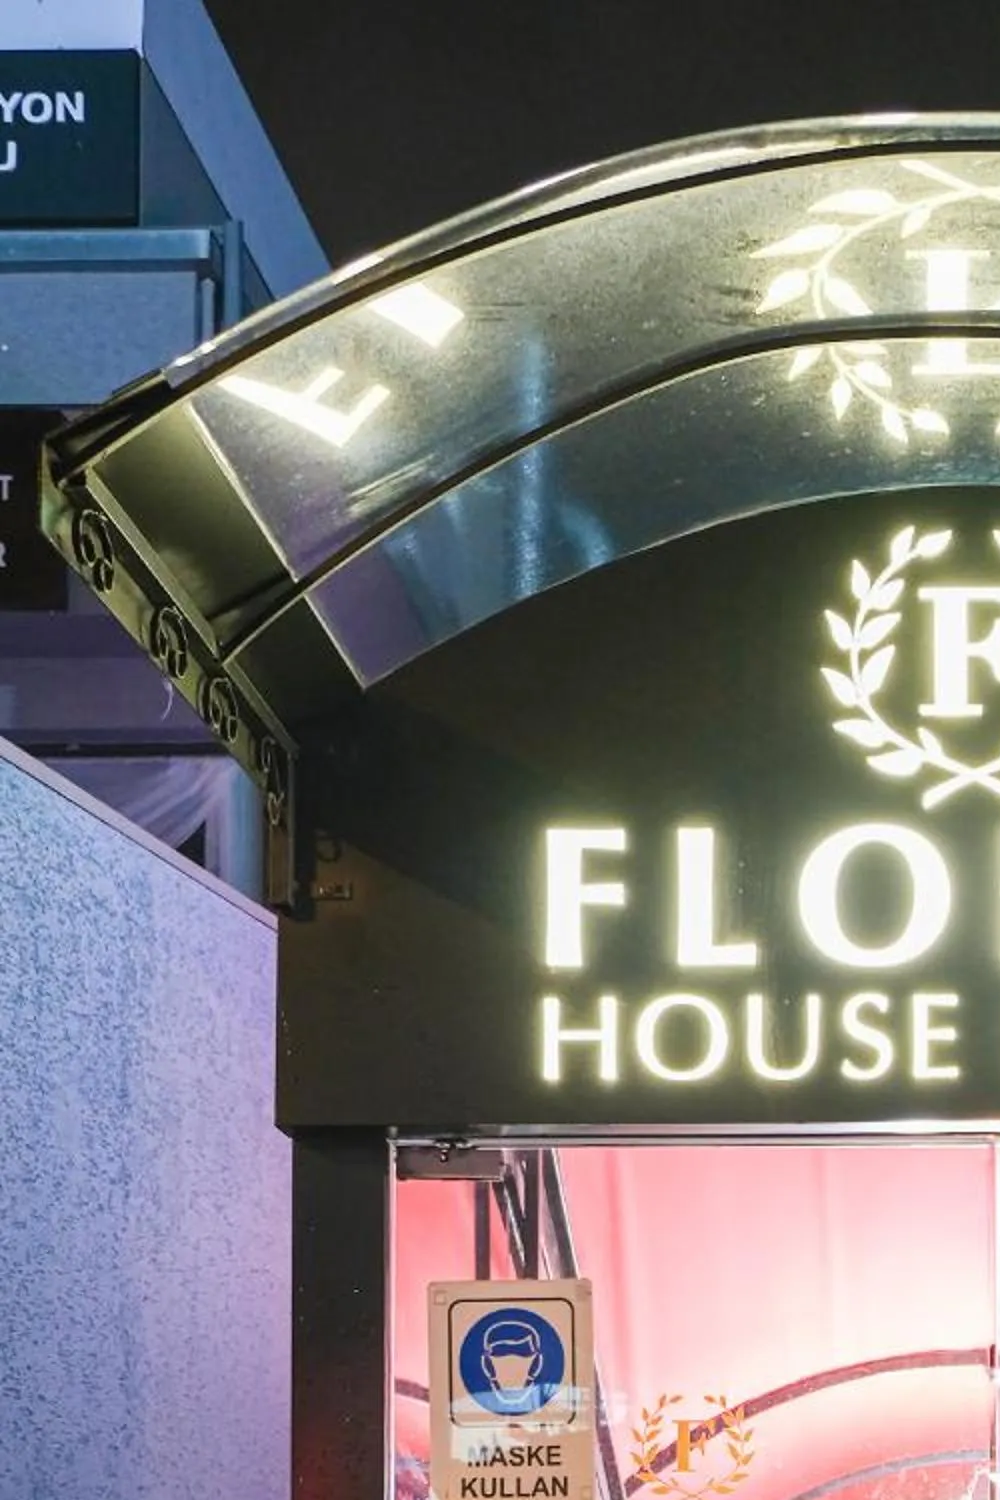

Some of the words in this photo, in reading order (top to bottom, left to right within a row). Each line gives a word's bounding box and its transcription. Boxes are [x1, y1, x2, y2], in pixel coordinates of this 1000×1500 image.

[0, 91, 85, 123] YON
[540, 992, 961, 1084] HOUSE
[467, 1445, 561, 1467] MASKE
[461, 1476, 569, 1498] KULLAN
